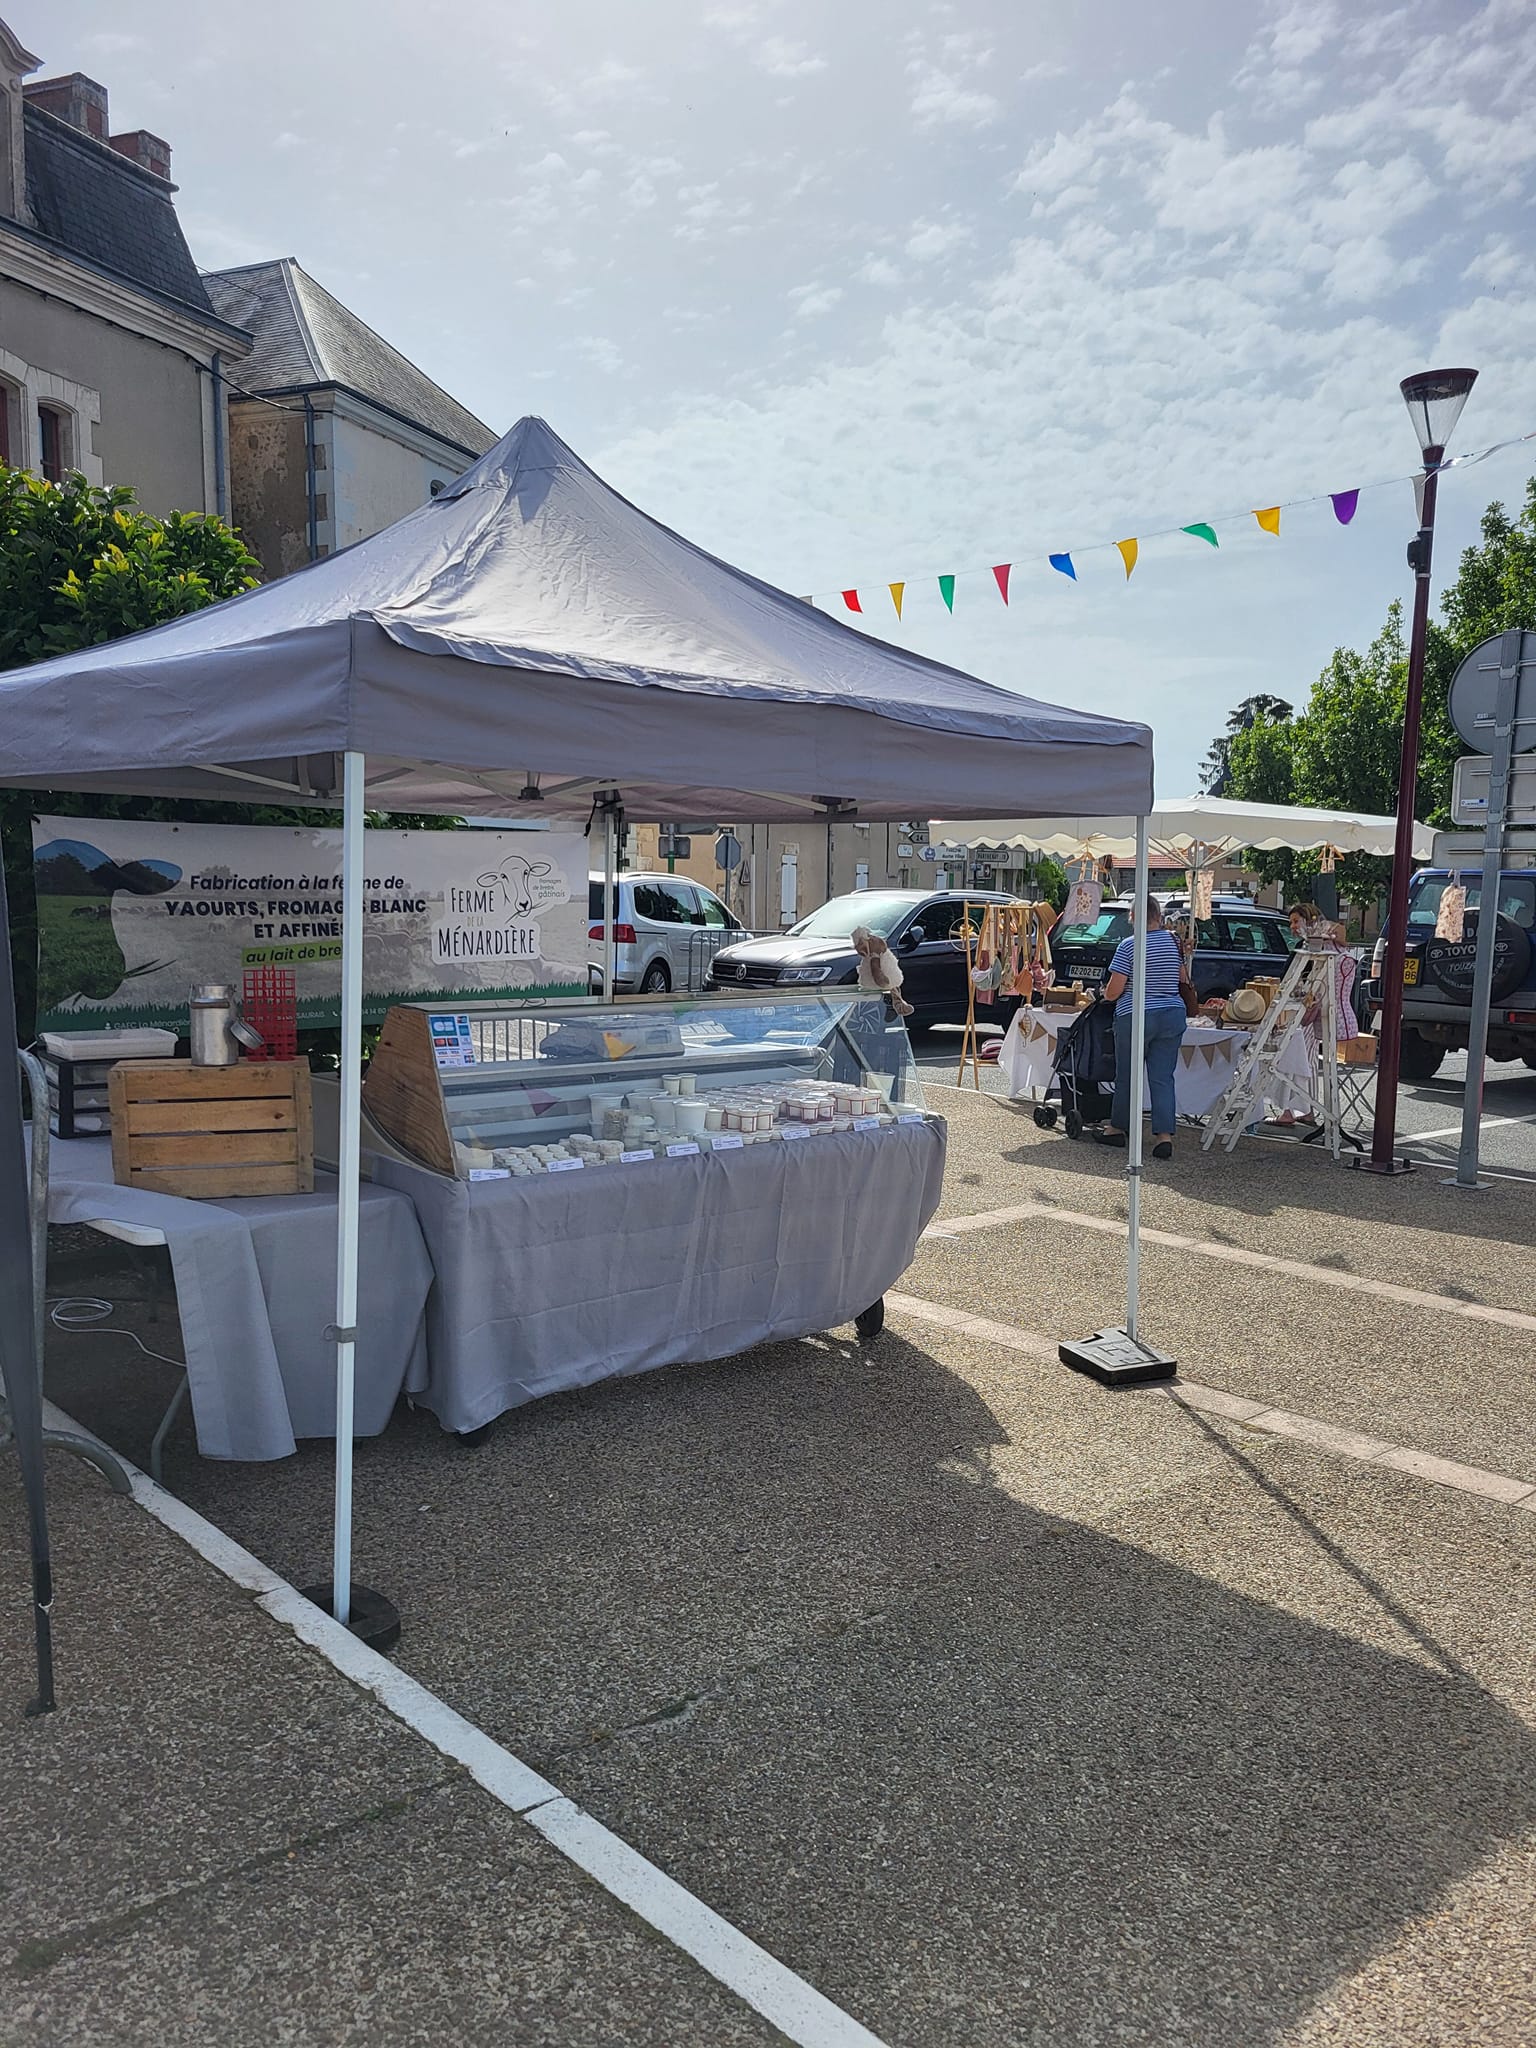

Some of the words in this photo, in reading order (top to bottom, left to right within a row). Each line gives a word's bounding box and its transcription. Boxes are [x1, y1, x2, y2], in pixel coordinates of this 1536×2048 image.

[190, 875, 294, 890] Fabrication
[299, 875, 308, 890] à
[313, 875, 329, 890] la
[384, 875, 404, 889] de
[451, 887, 494, 913] FERME
[538, 890, 565, 898] gâtinais
[165, 901, 264, 918] YAOURTS,
[268, 900, 365, 916] FROMAG
[370, 899, 426, 913] BLANC
[254, 924, 274, 938] ET
[280, 918, 343, 937] AFFINÉ
[438, 925, 535, 957] MÉNARDIÈRE
[246, 952, 265, 963] au
[270, 948, 293, 961] lait
[298, 947, 314, 959] de
[1445, 944, 1477, 957] TOYO
